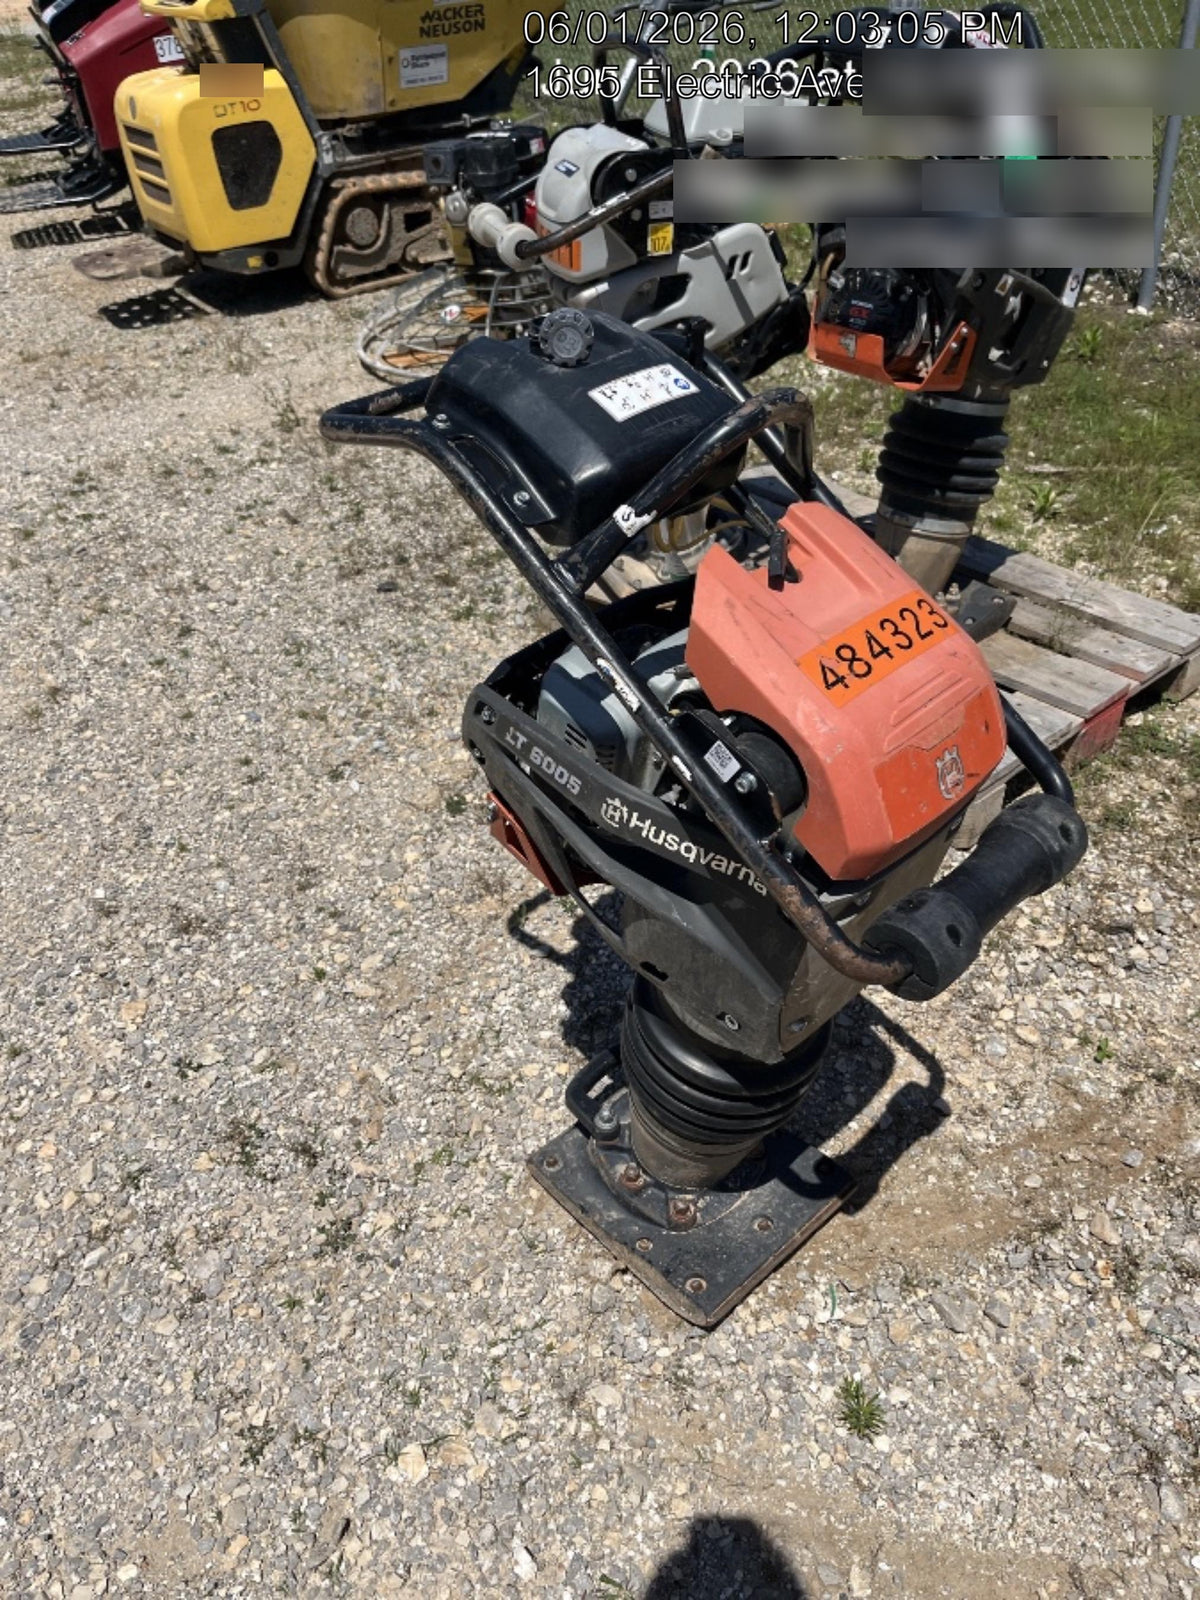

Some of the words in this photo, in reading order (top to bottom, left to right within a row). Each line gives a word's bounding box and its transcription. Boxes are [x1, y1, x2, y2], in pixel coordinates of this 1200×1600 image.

[419, 18, 486, 38] NEUSON
[420, 4, 486, 24] WACKER
[819, 598, 949, 690] 484323
[506, 726, 528, 750] LT
[530, 745, 582, 796] 6005
[629, 811, 768, 897] Husqvarna
